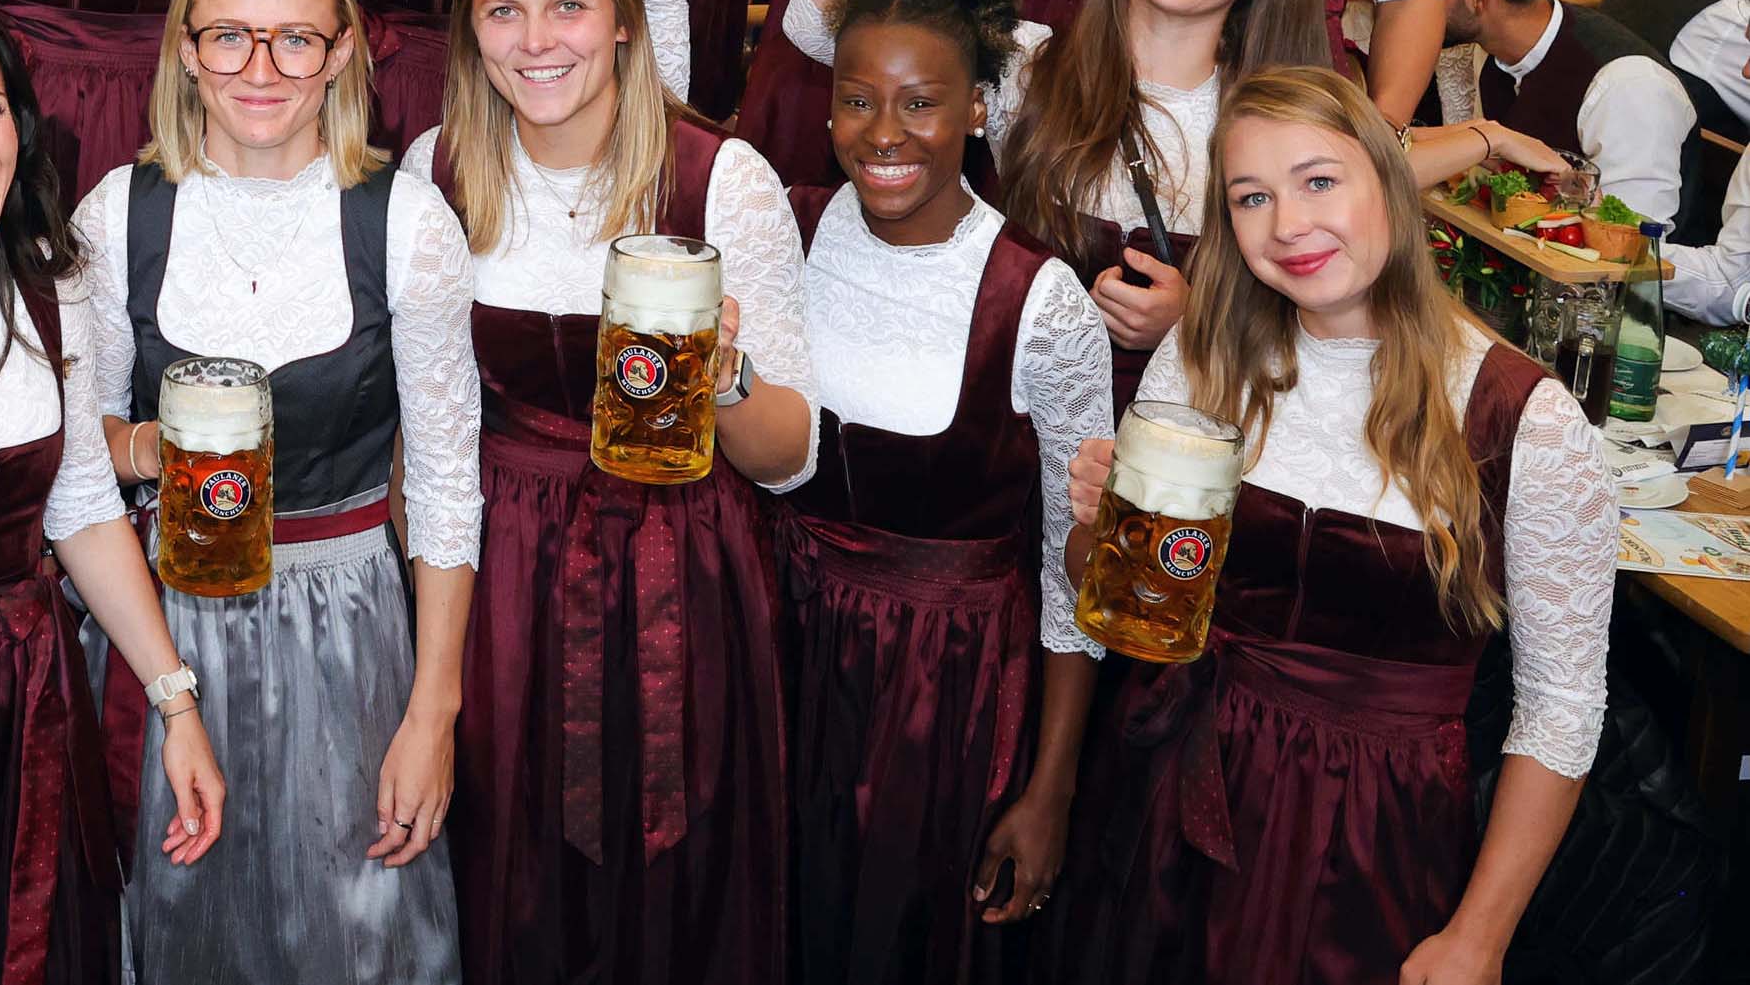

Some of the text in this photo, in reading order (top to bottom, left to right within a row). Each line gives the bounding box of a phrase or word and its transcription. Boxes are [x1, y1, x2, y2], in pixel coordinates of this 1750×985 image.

[619, 349, 662, 368] PAULANER
[621, 378, 658, 395] MÜNCHEN
[205, 472, 247, 490] PAULANER
[1165, 529, 1210, 549] PAULANER
[1164, 561, 1203, 577] MÜNCHEN
